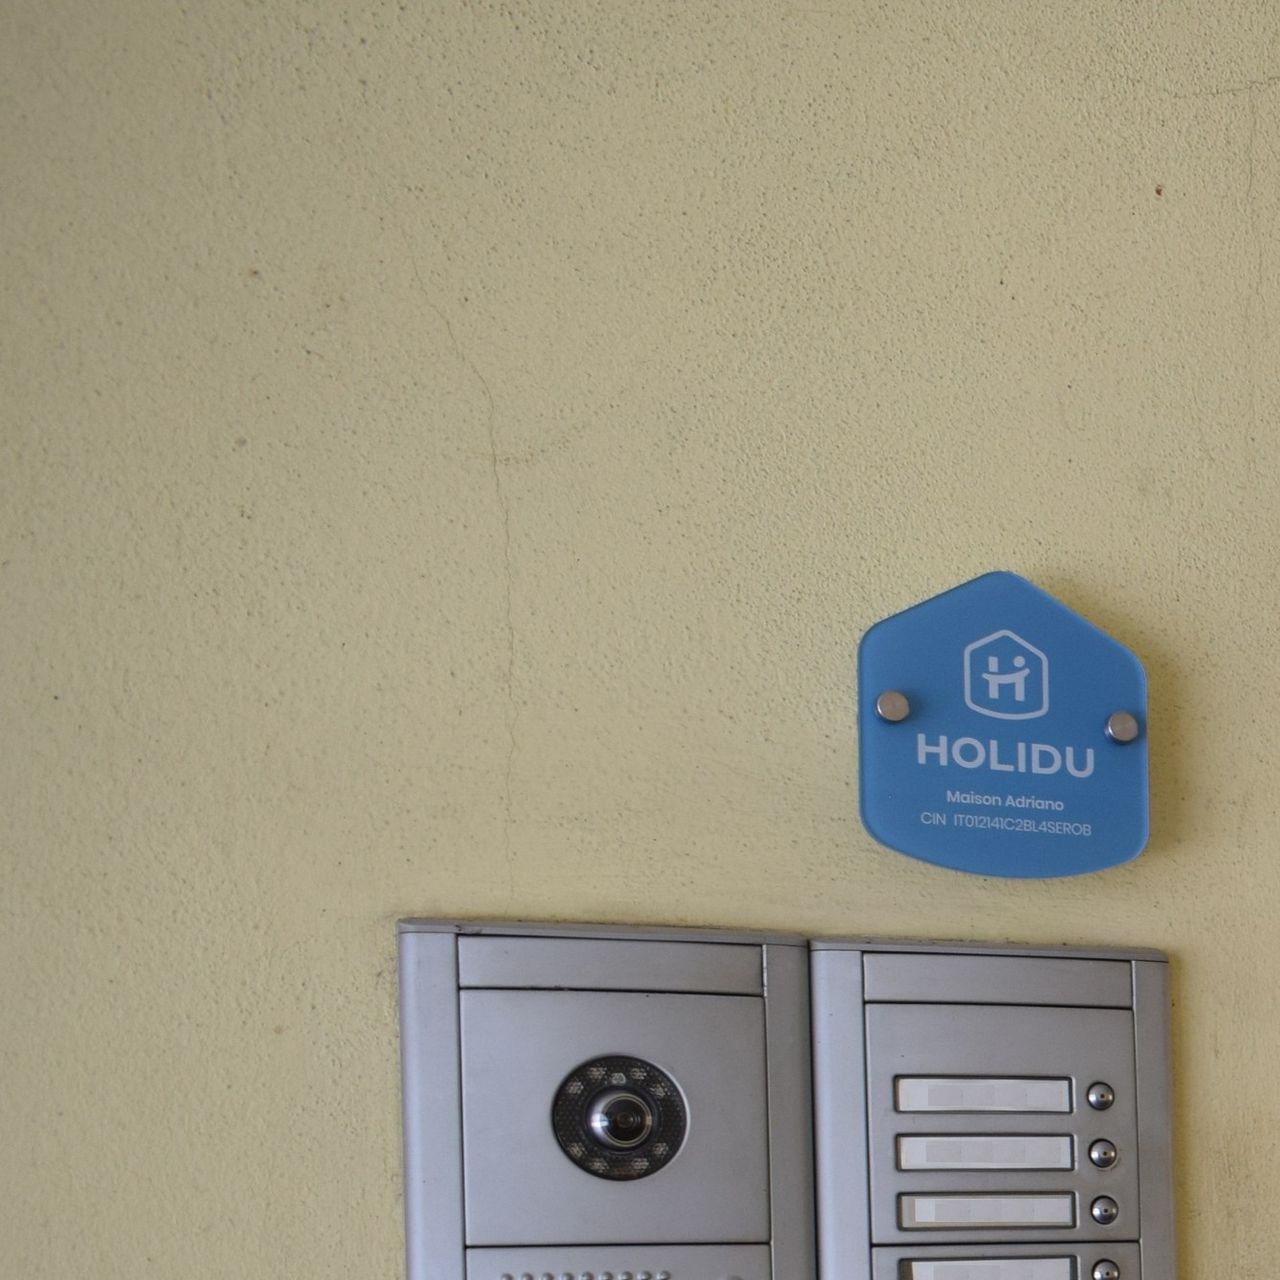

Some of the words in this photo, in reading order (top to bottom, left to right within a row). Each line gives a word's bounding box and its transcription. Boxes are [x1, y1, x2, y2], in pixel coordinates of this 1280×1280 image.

[917, 734, 1095, 778] HOLIDU
[946, 790, 1002, 807] Maison
[1005, 796, 1065, 811] Adriano
[920, 812, 947, 825] CIN
